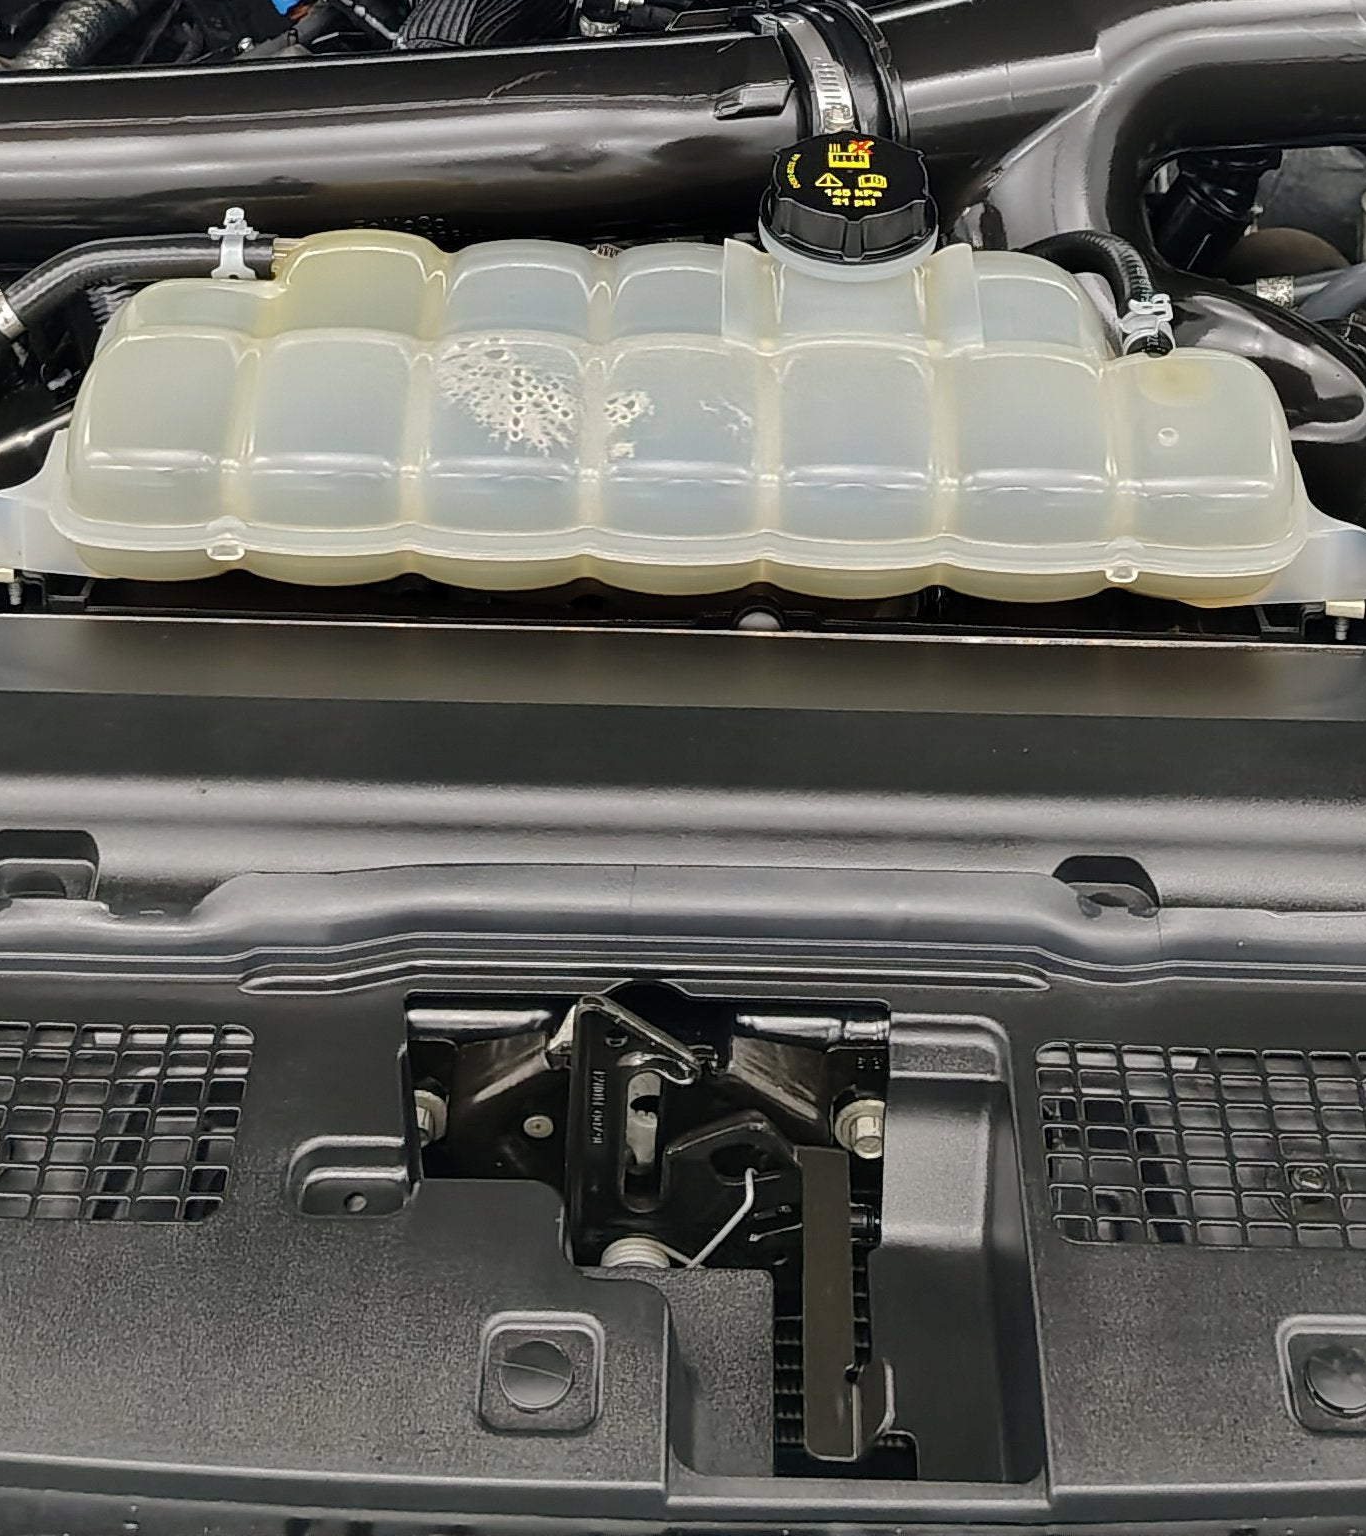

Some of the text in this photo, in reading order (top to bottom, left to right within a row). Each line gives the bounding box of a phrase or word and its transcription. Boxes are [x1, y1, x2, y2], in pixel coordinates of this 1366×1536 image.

[824, 188, 882, 198] 145 kPa
[832, 197, 876, 207] 21 psi
